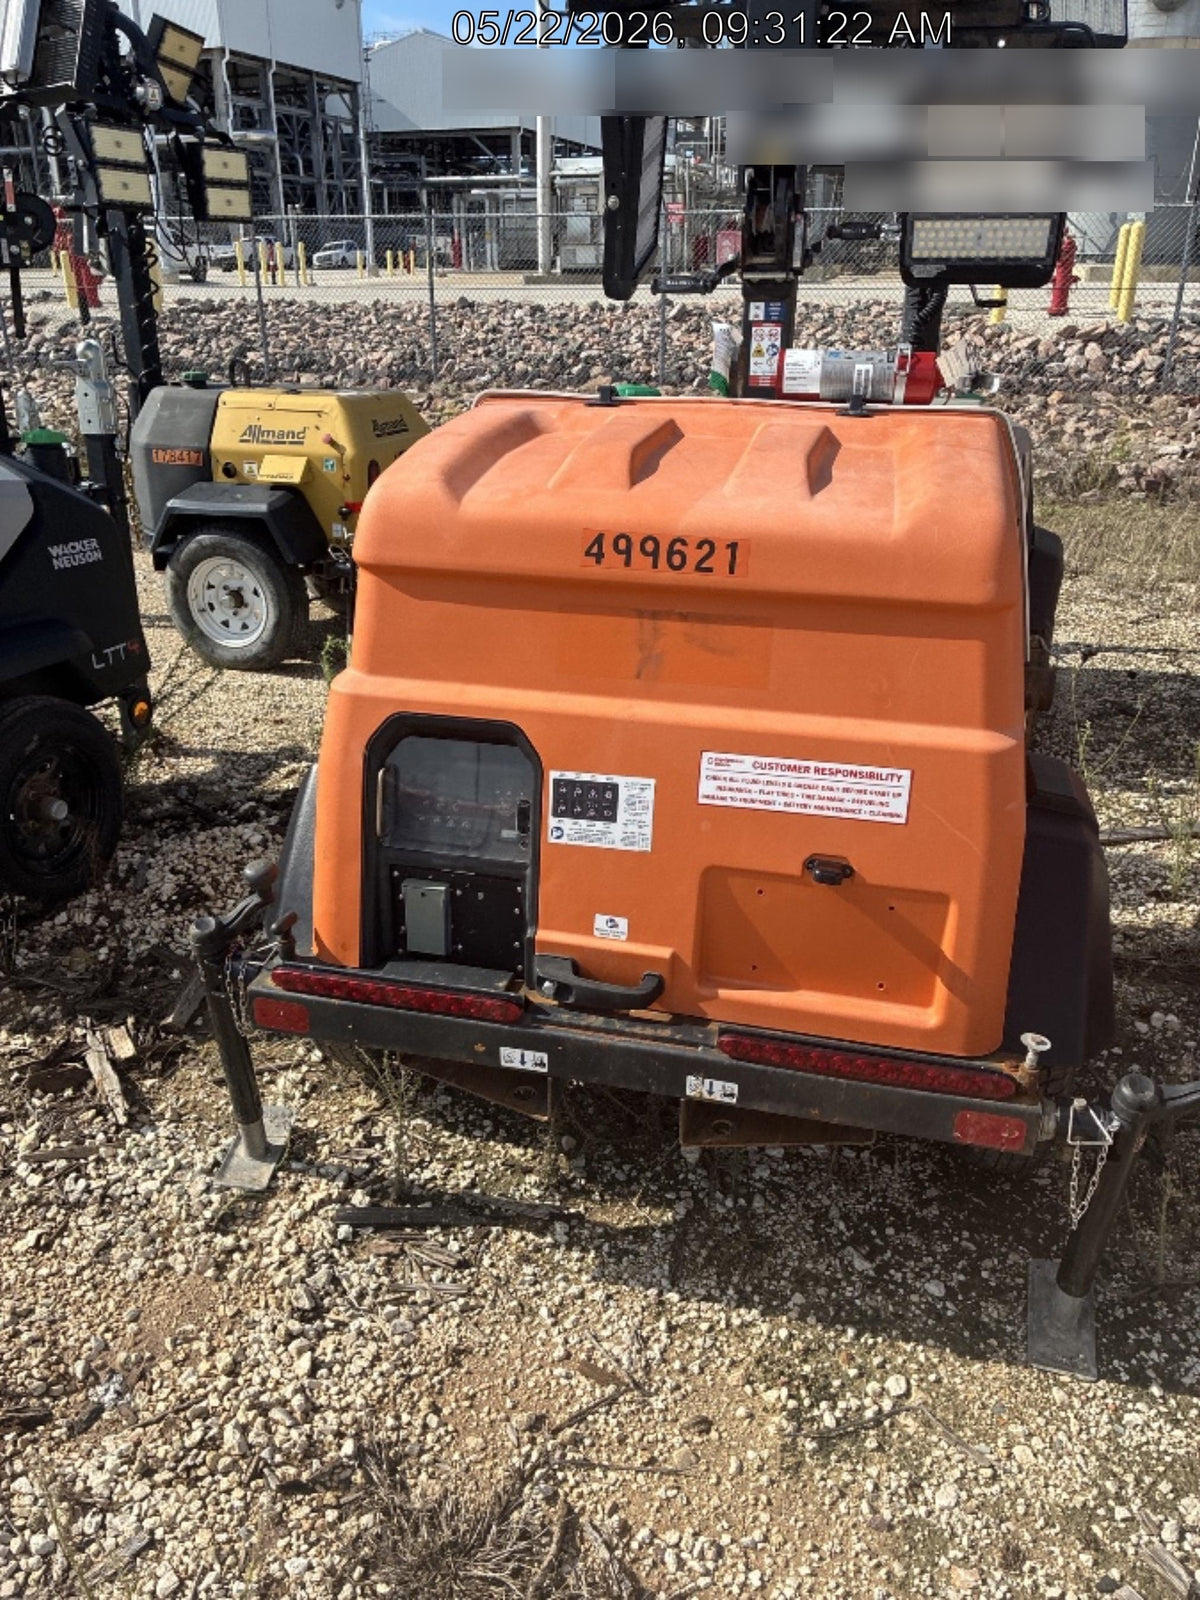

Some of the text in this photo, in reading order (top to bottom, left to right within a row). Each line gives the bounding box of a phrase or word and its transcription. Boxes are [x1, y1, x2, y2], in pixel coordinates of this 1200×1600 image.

[239, 424, 307, 445] Allmand
[47, 538, 100, 558] WACKER
[584, 532, 740, 575] 499621
[52, 549, 103, 570] NEUSON
[752, 761, 812, 774] CUSTOMER
[813, 766, 905, 783] RESPONSIBILITY
